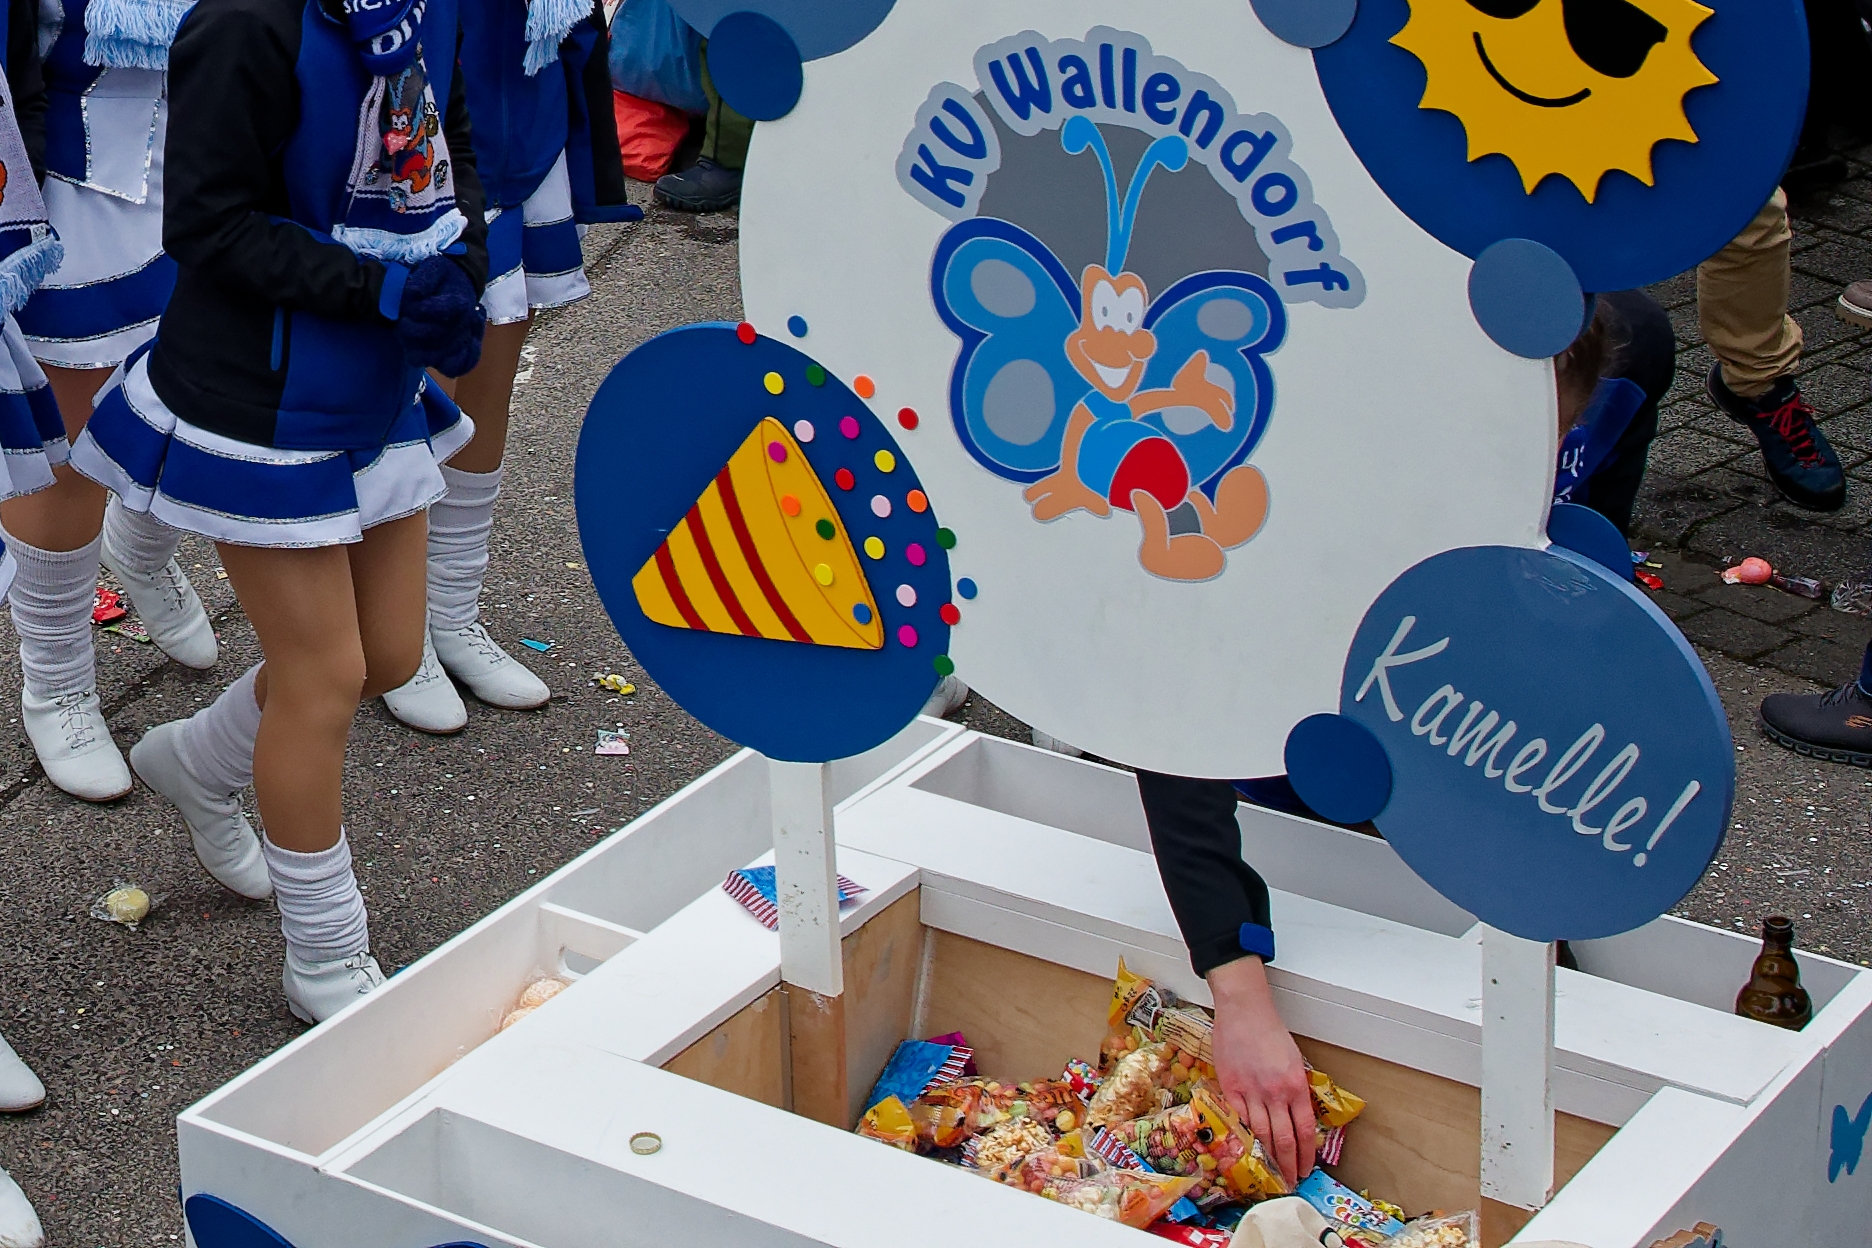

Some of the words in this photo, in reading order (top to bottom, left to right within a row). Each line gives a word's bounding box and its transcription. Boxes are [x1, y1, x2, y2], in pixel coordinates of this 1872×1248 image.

[910, 97, 988, 209] KV
[988, 42, 1351, 292] Wallendorf
[1355, 615, 1702, 868] Kamelle!
